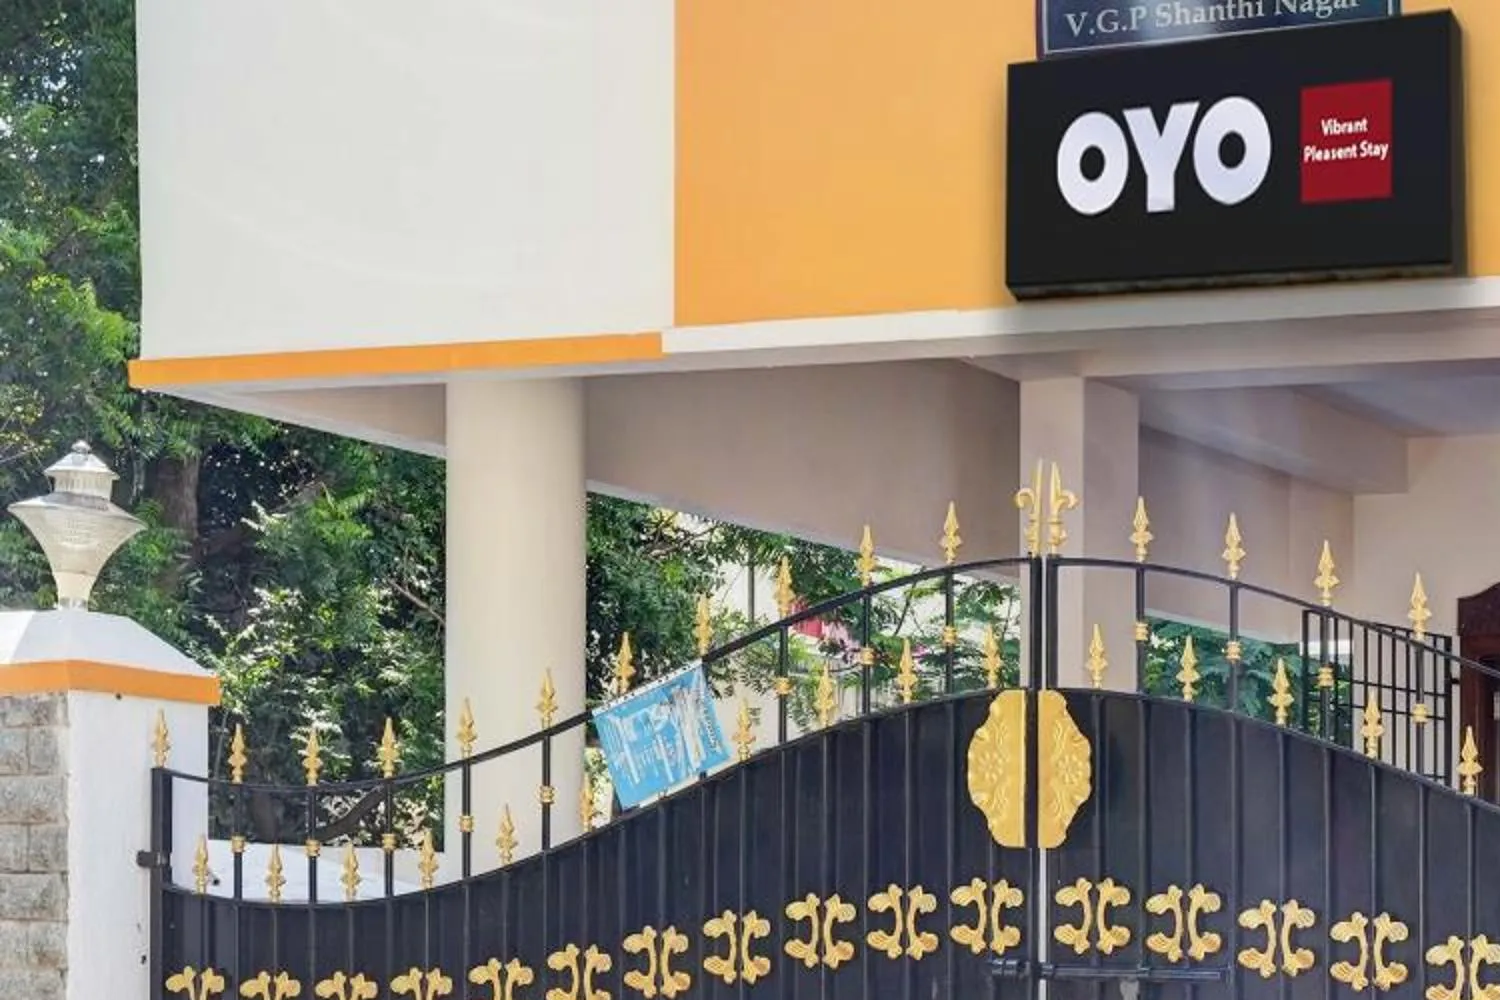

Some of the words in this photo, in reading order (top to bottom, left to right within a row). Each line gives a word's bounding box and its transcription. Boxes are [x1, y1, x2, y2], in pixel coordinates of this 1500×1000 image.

[1066, 6, 1148, 37] V.G.P
[1155, 0, 1264, 28] Shanthi
[1321, 117, 1368, 136] Vibrant
[1057, 96, 1271, 216] OYO
[1360, 140, 1389, 160] Stay
